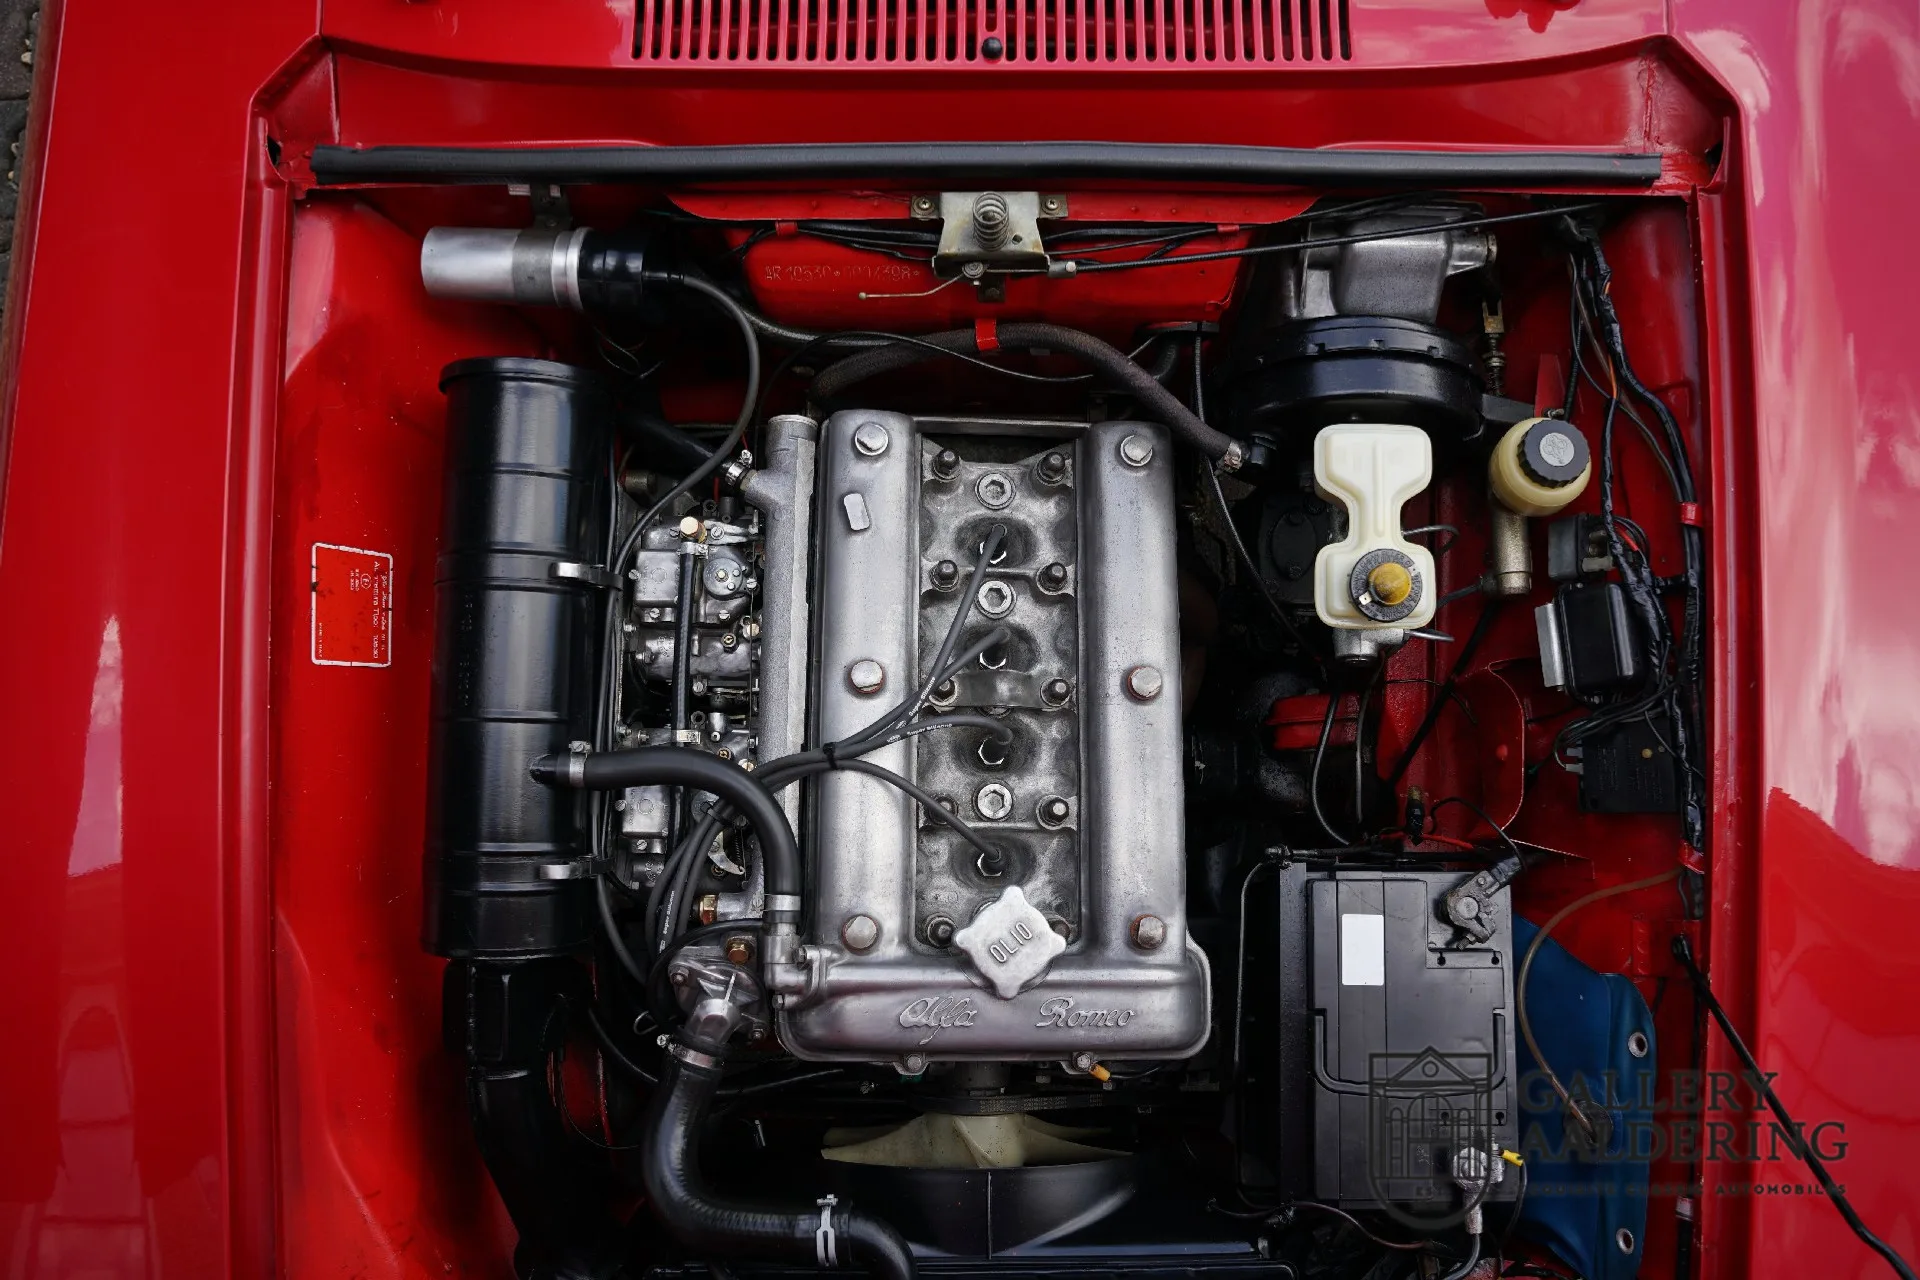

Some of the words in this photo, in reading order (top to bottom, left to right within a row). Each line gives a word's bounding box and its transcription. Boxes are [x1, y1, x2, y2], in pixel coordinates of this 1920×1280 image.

[989, 921, 1033, 964] OLIO
[899, 995, 978, 1046] Alfa
[1034, 995, 1135, 1028] Romeo
